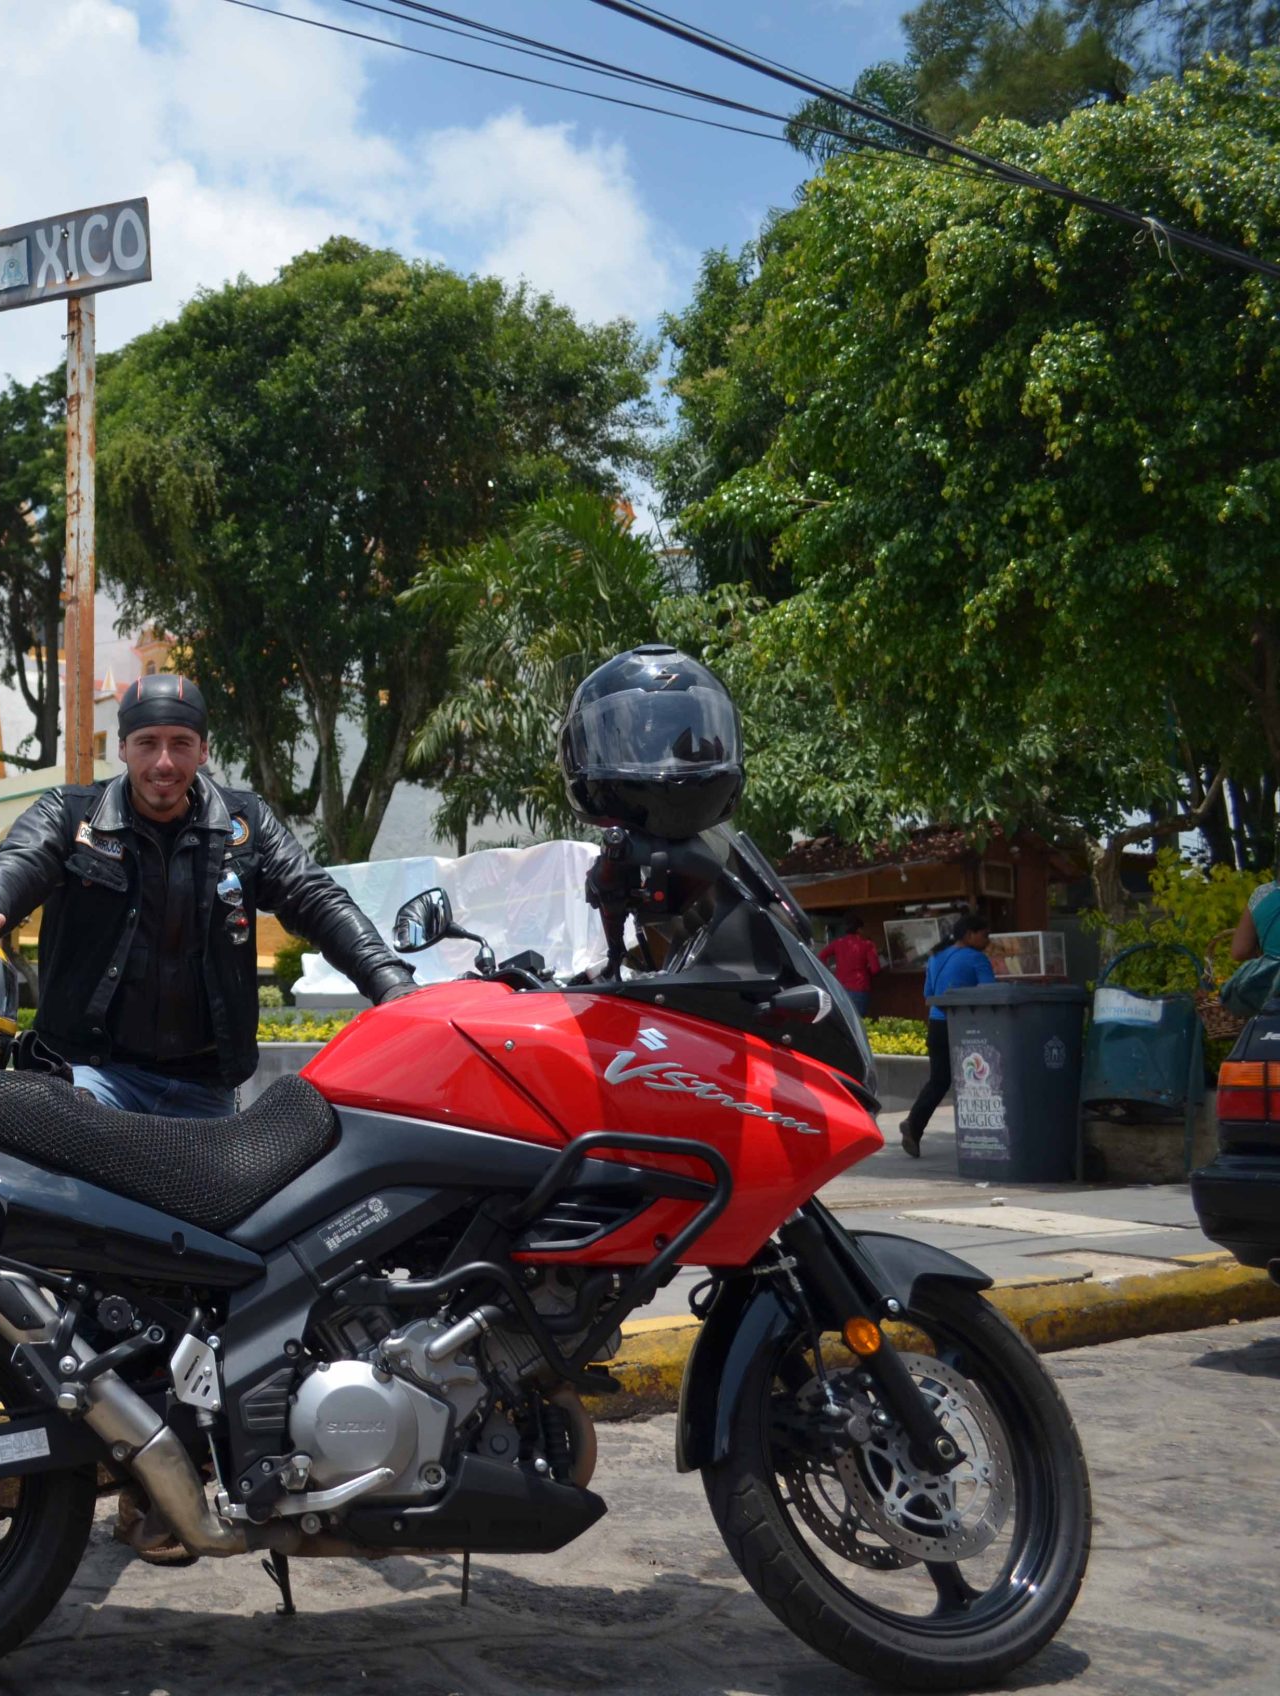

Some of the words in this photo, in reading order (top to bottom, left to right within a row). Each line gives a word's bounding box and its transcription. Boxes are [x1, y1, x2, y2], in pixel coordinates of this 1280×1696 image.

[35, 208, 147, 288] XICO
[959, 1098, 1001, 1113] PUEBLO
[327, 1421, 387, 1434] SUZUKI
